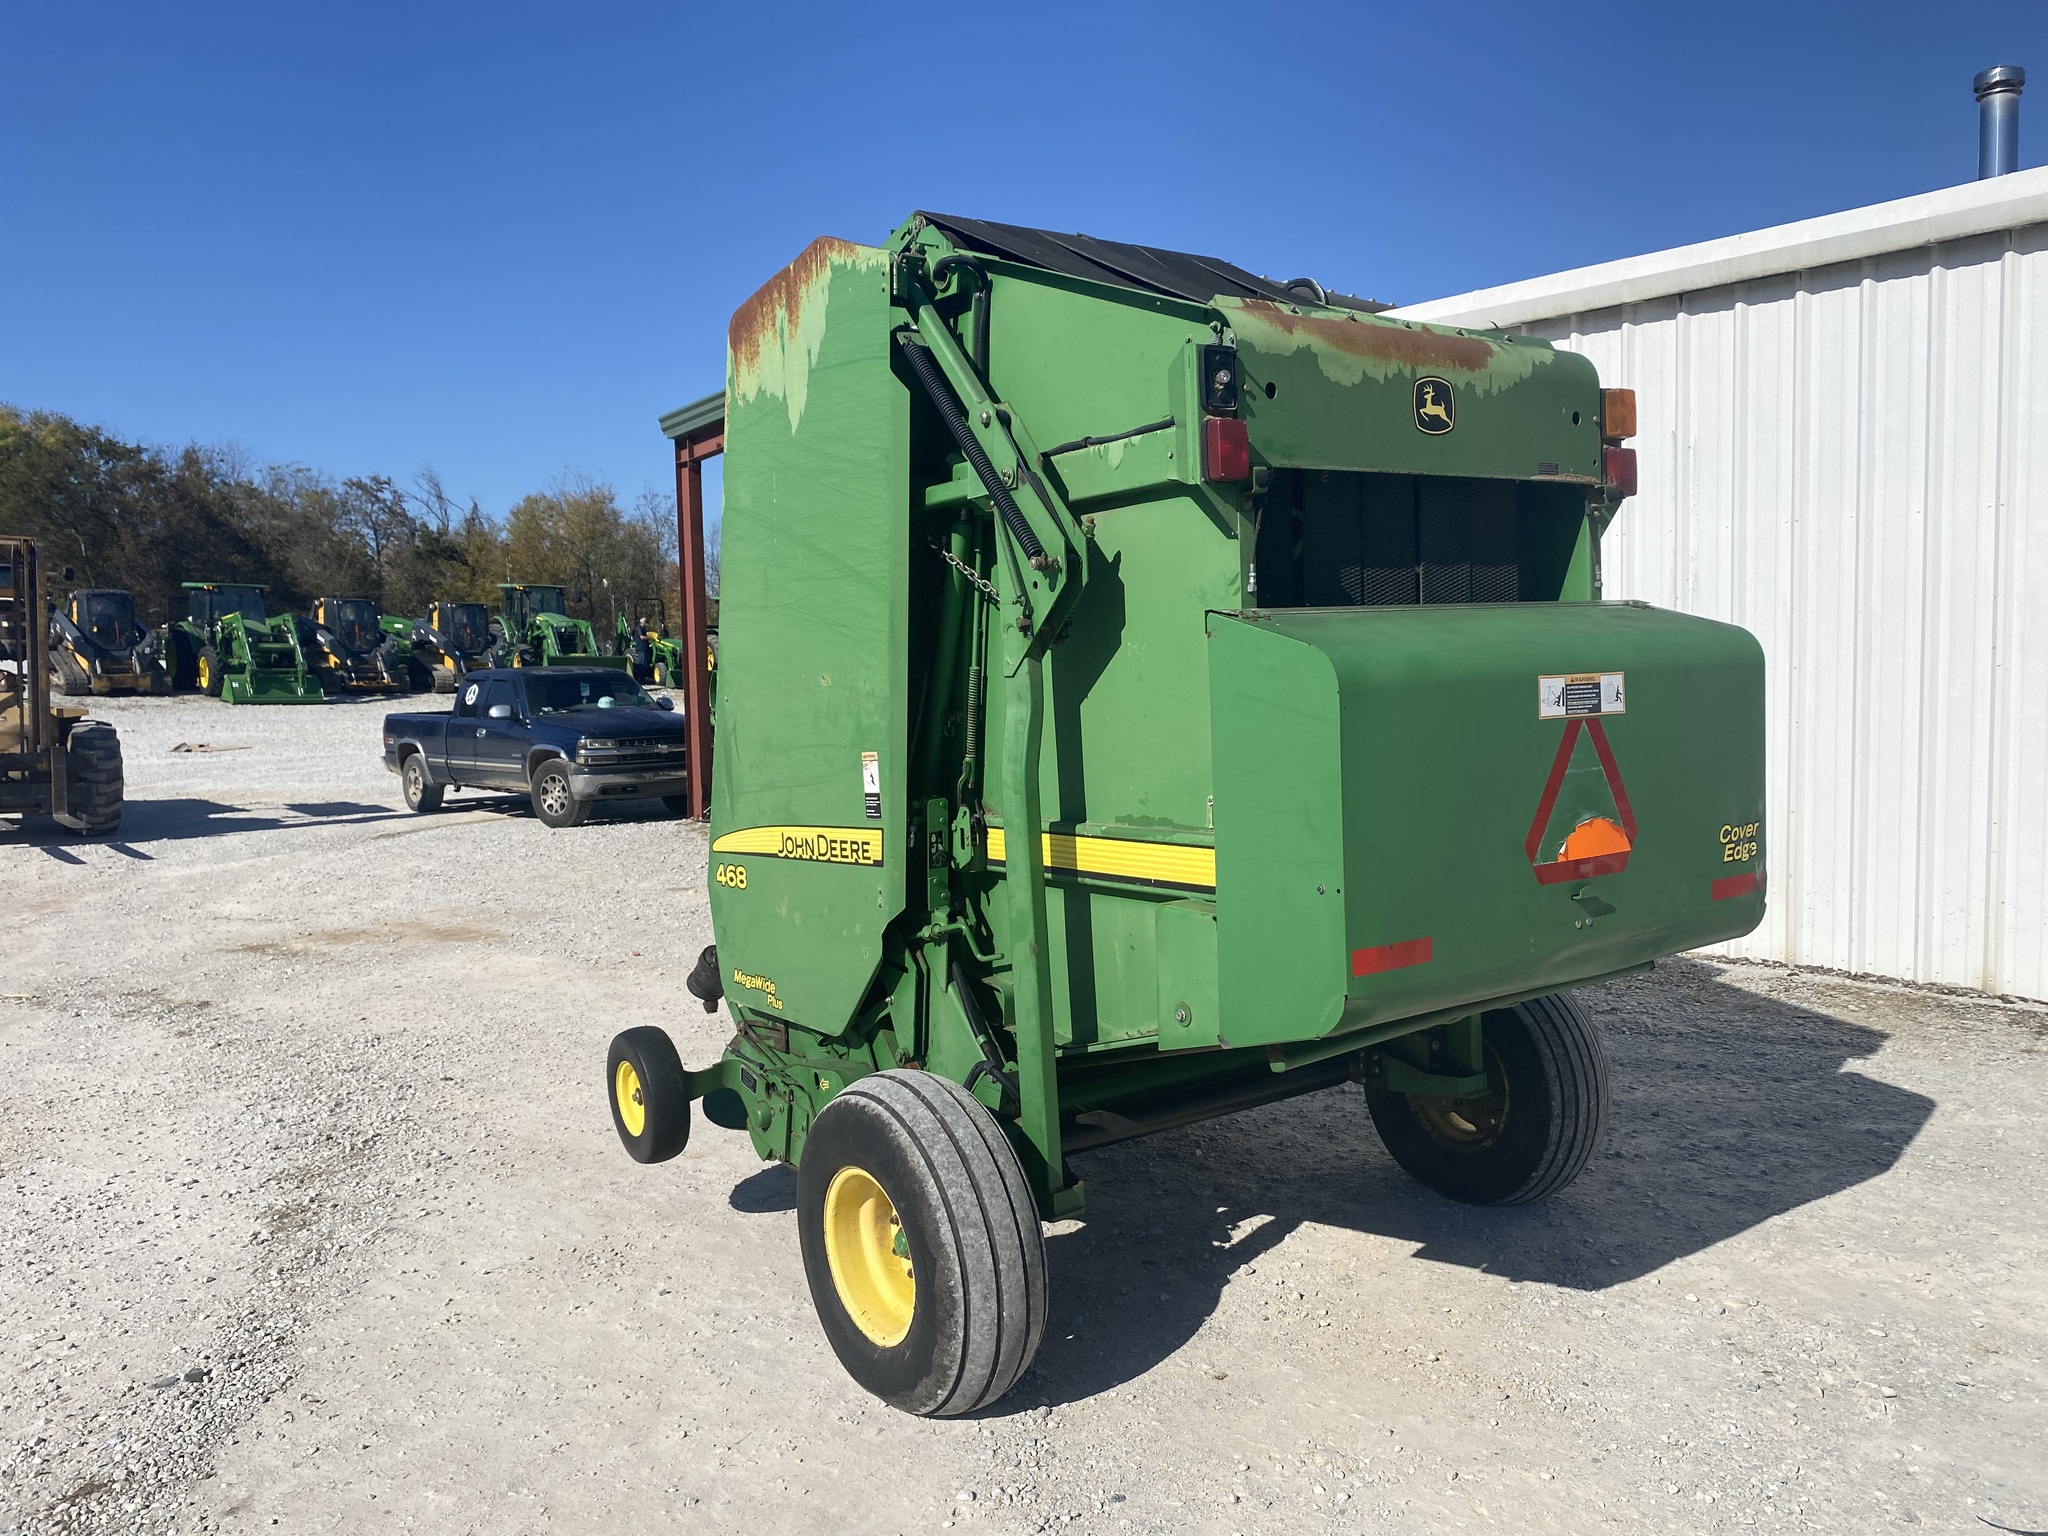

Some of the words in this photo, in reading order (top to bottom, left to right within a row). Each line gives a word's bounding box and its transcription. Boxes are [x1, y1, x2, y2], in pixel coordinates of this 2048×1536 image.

[1719, 821, 1760, 844] Cover
[778, 832, 815, 857] JOHN
[816, 834, 872, 861] DEERE
[1723, 841, 1758, 862] Edge
[716, 863, 748, 890] 468
[733, 968, 776, 994] MegaWide
[767, 994, 784, 1010] Plus
